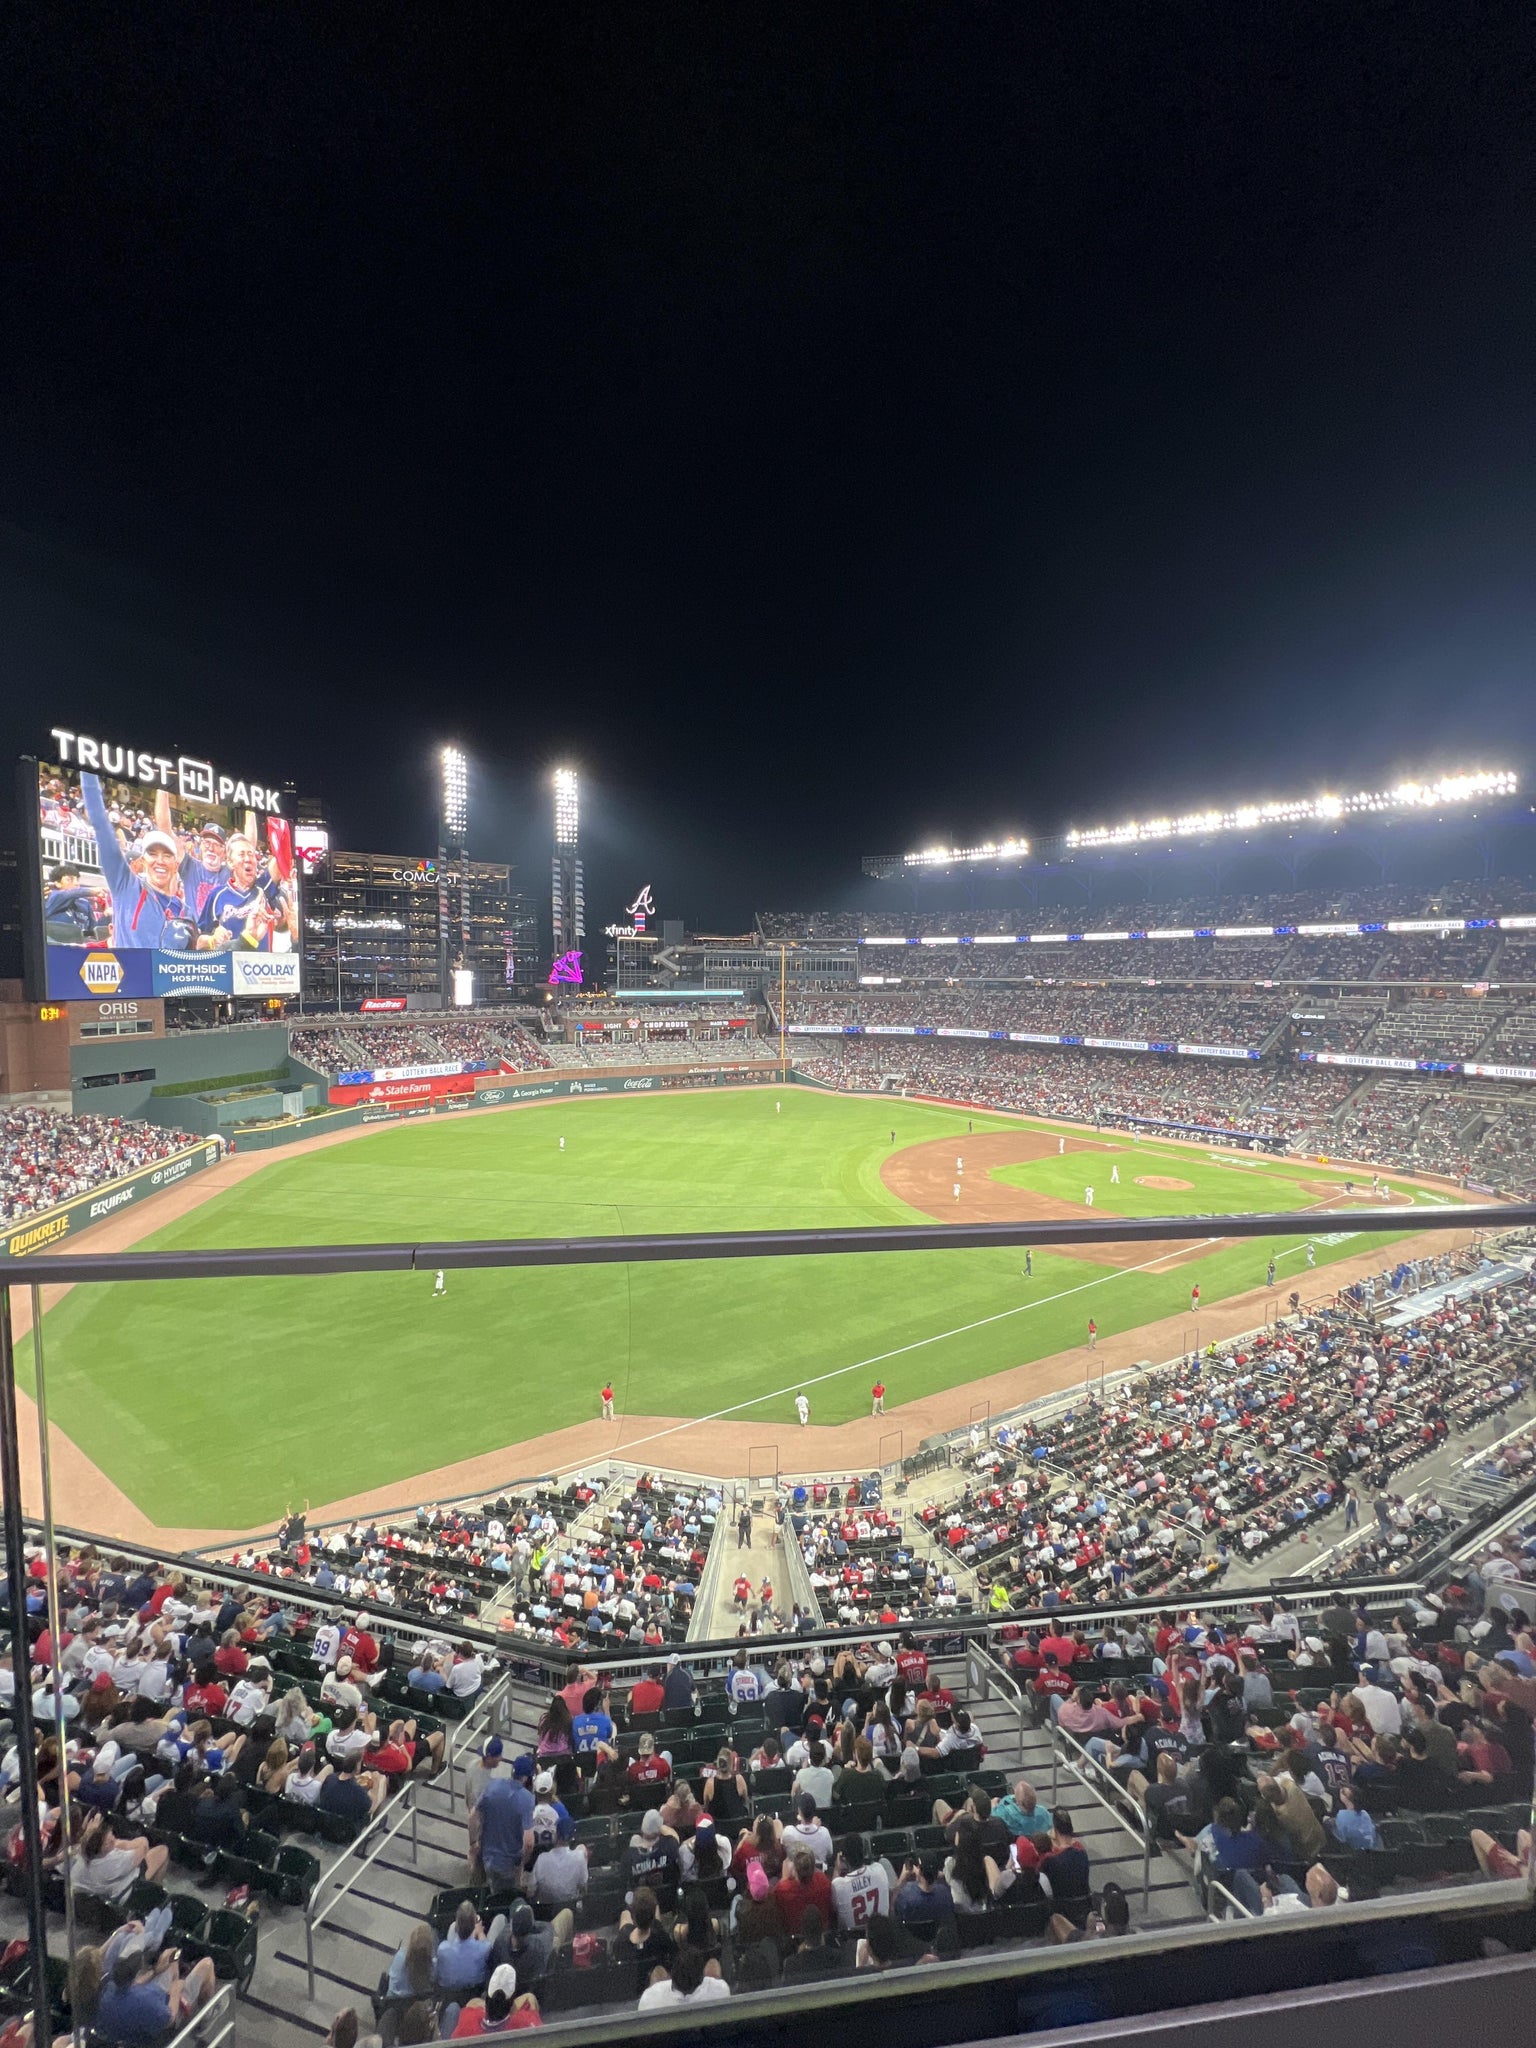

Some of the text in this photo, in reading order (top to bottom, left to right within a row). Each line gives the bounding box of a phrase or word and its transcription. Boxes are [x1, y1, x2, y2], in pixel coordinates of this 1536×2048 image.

[51, 728, 280, 813] TRUIST PARK
[605, 924, 638, 937] xfinity
[88, 964, 117, 983] NAPA
[158, 963, 227, 975] NORTHSIDE
[243, 963, 296, 976] COOLRAY
[172, 975, 216, 983] HOSPITAL
[98, 1002, 139, 1015] ORIS
[365, 1001, 402, 1009] RaceTrac
[1495, 1068, 1528, 1077] LOTTERY
[385, 1083, 431, 1096] State Farm
[163, 1157, 192, 1179] HYUNDAI
[90, 1187, 134, 1218] EQUIFAX
[9, 1215, 70, 1254] QUIKRETE
[313, 1638, 331, 1657] 99
[851, 1875, 872, 1892] RILEY
[850, 1887, 880, 1927] 27
